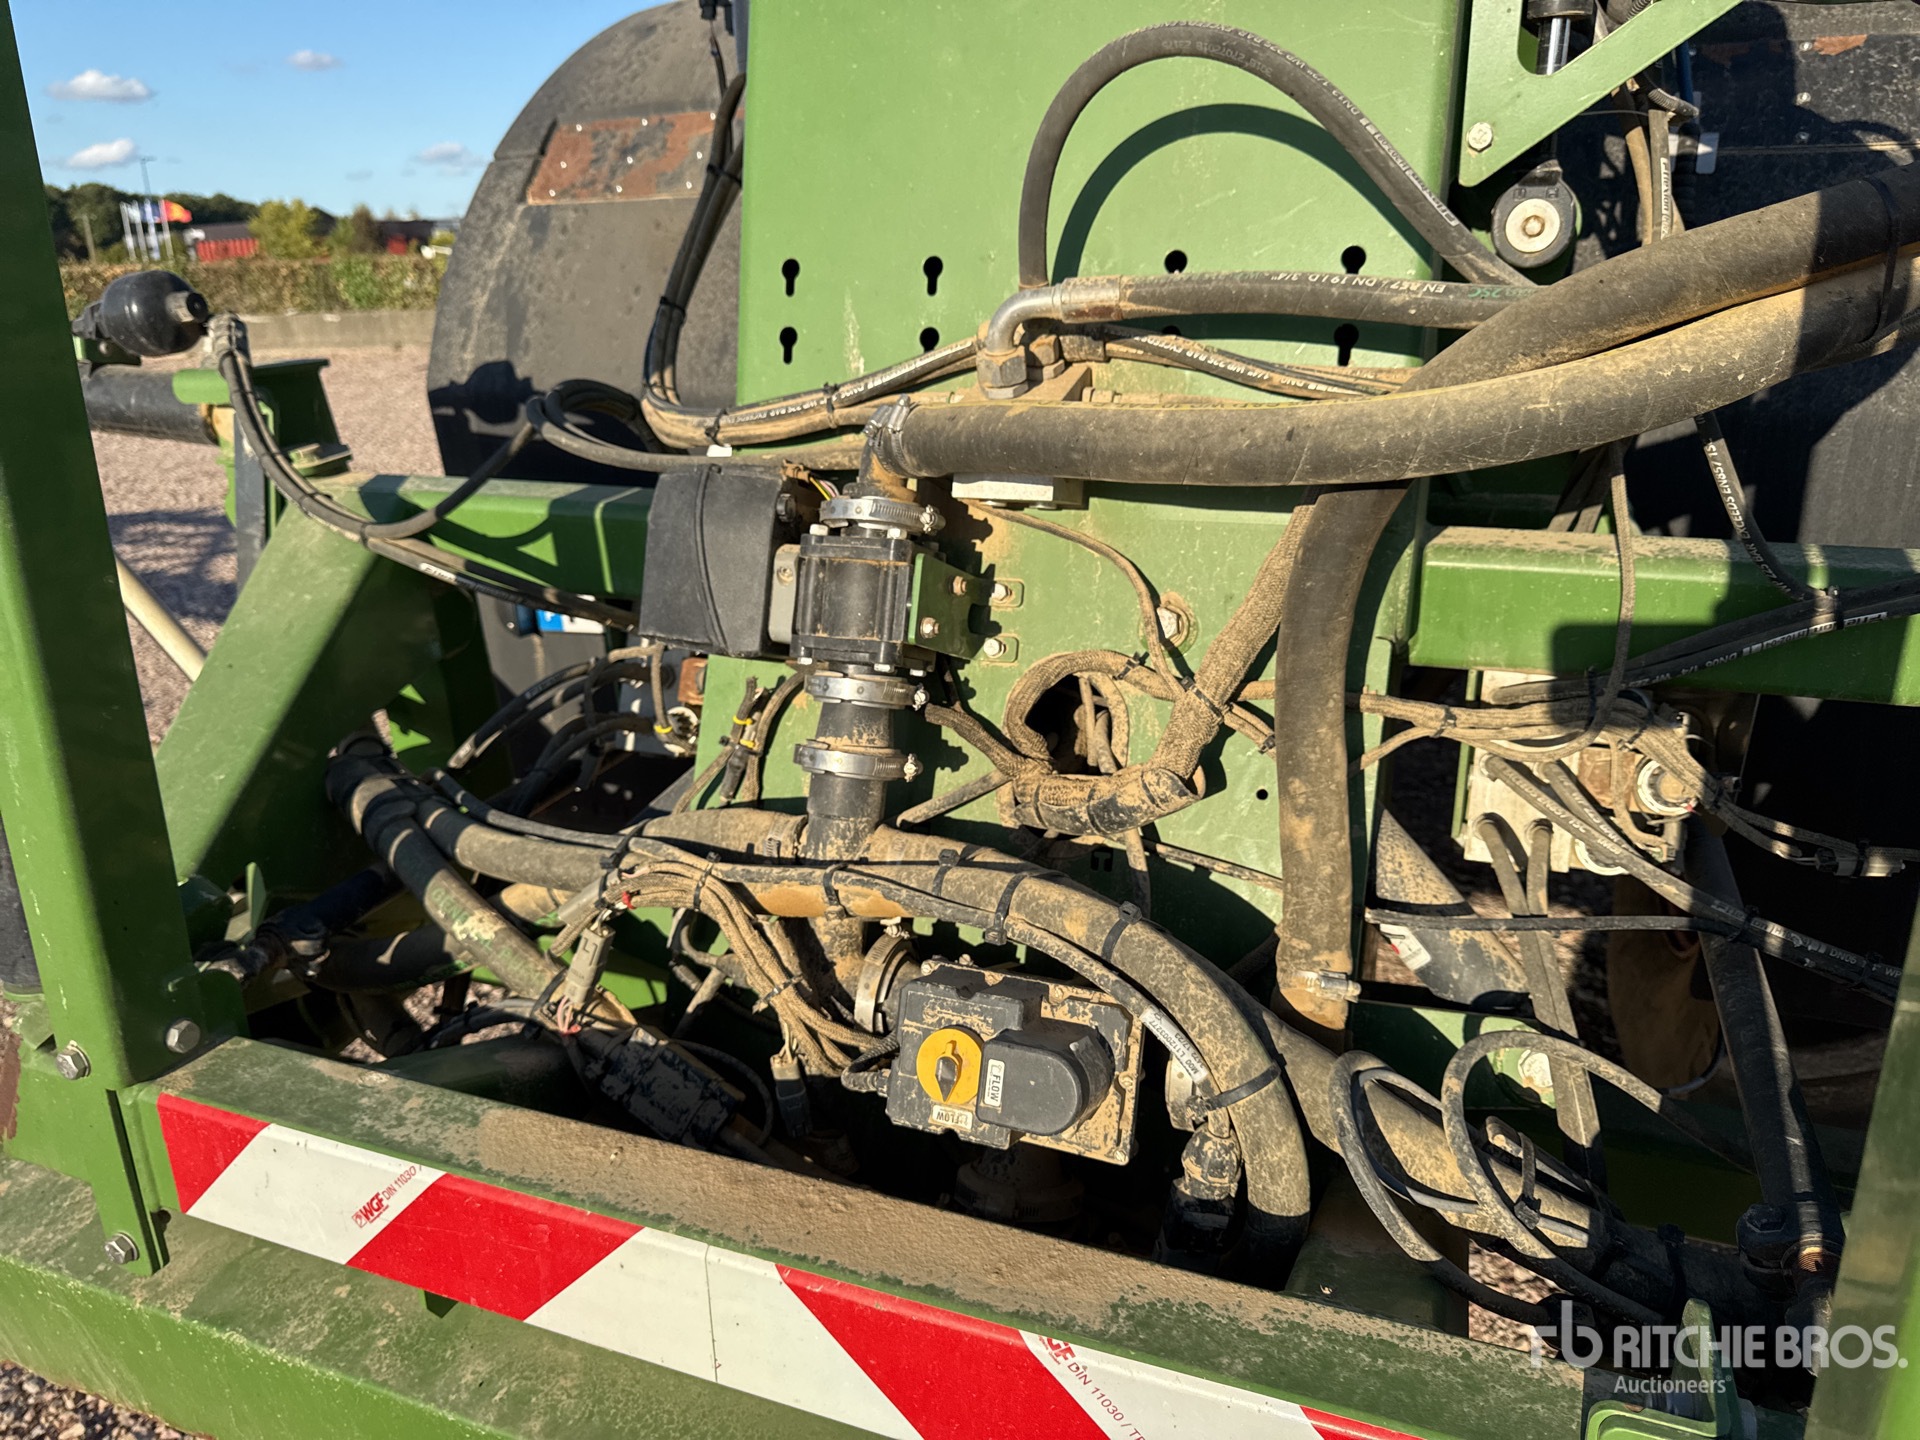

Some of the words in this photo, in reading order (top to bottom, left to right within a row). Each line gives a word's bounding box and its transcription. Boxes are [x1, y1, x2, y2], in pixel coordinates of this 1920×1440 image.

[1352, 276, 1377, 287] DN
[1422, 281, 1447, 294] EN
[1185, 349, 1207, 362] BAR
[1712, 461, 1732, 495] EN857
[1725, 495, 1751, 540] EXCEEDS
[1745, 543, 1760, 562] BAR
[1760, 563, 1777, 581] 225
[990, 1073, 1001, 1102] FLOW
[936, 1111, 960, 1124] FLOW
[359, 1192, 384, 1221] WGF
[381, 1185, 398, 1201] DIN
[394, 1165, 418, 1188] 11030
[1067, 1361, 1093, 1386] DIN
[1091, 1386, 1125, 1423] 11030
